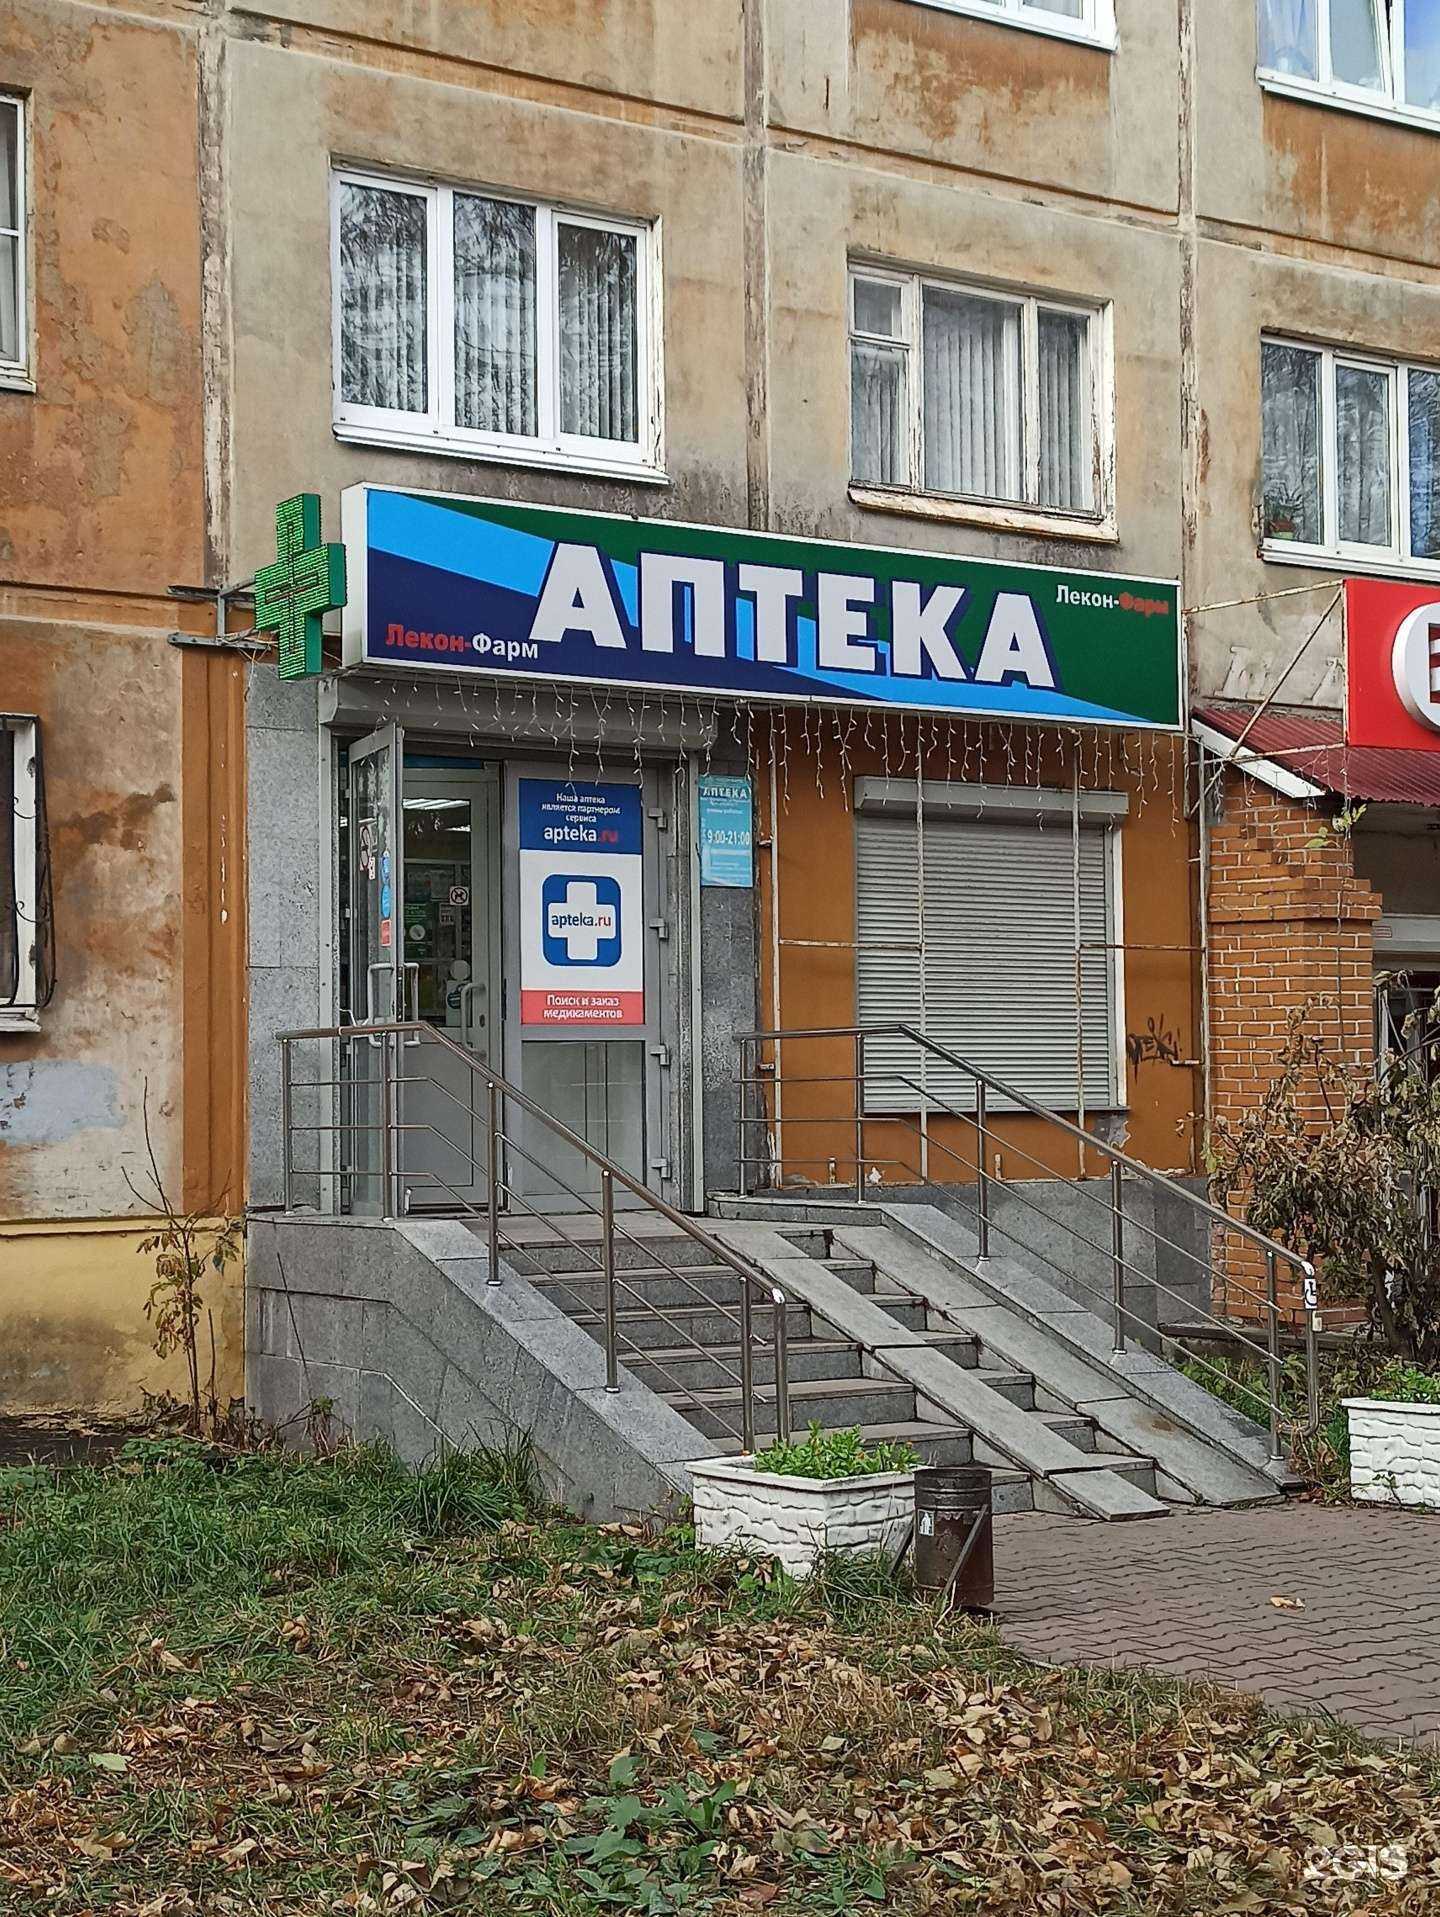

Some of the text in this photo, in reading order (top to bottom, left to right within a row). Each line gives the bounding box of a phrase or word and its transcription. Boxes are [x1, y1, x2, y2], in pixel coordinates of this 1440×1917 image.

[1056, 584, 1169, 618] Лекон-Фарм
[529, 542, 1056, 688] АПТЕКА
[385, 623, 538, 662] Лекон-Фарм
[556, 793, 606, 804] Наша аптека
[703, 787, 747, 800] АПТЕКА
[541, 803, 576, 813] является
[565, 815, 597, 824] сервиса
[544, 825, 619, 843] apteka.ru
[552, 912, 611, 929] apteka.ru
[547, 994, 619, 1007] Поиск и заказ
[543, 1008, 623, 1020] медикаментов
